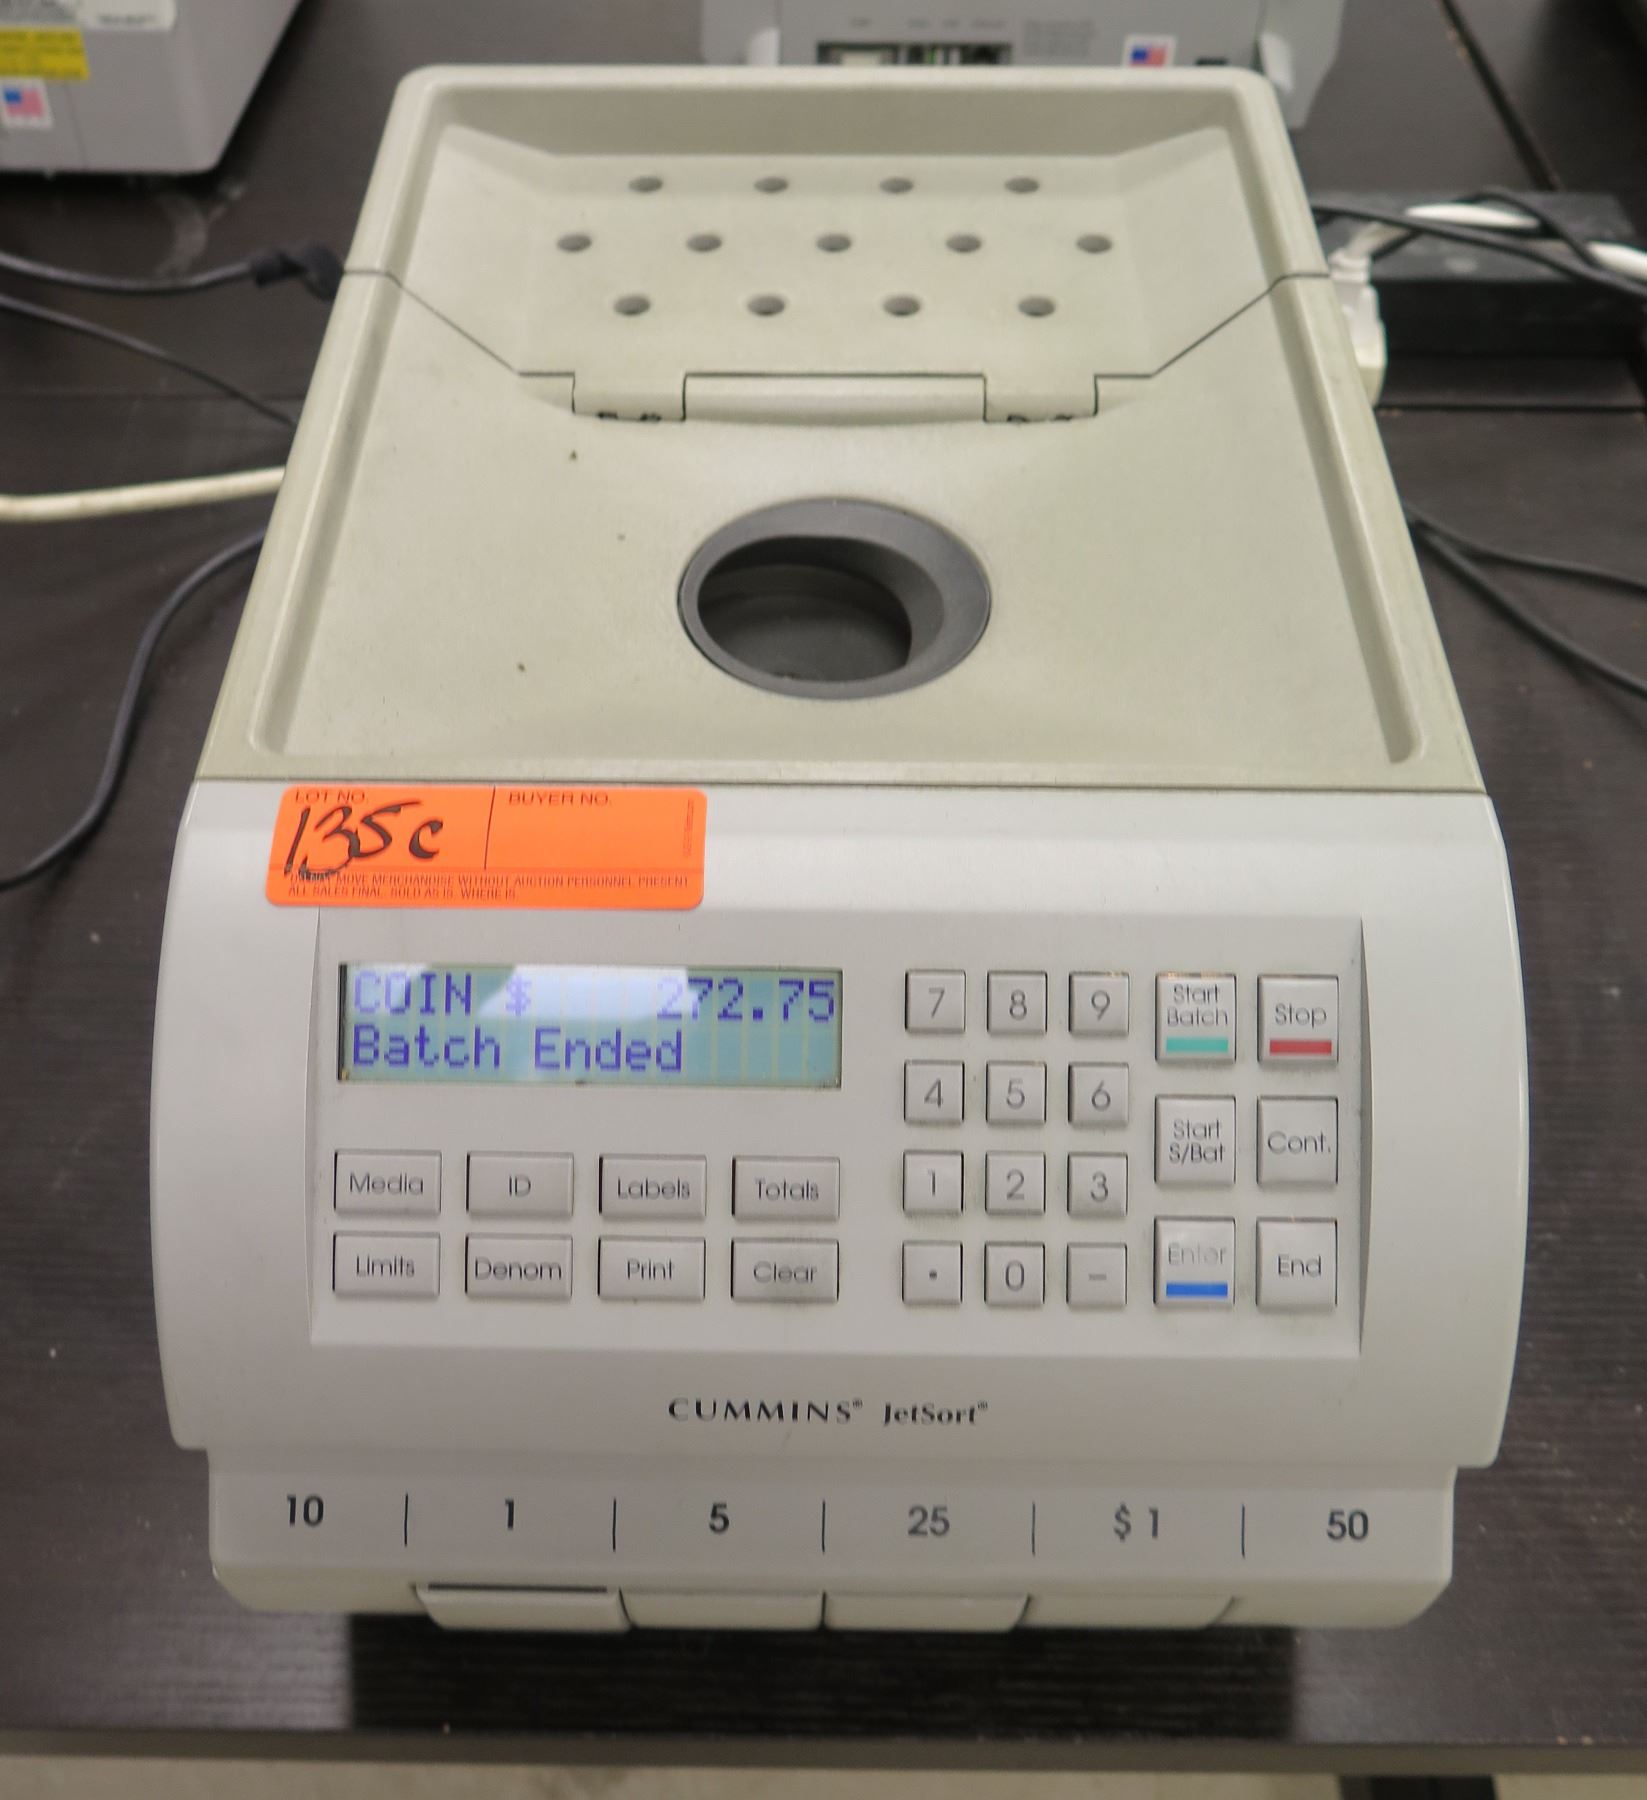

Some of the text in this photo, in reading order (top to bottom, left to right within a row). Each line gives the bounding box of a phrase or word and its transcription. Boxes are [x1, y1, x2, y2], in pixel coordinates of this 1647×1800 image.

[295, 789, 369, 802] LOT NO.
[509, 791, 613, 807] BUYER NO.
[458, 874, 508, 887] WITHOUT
[514, 875, 563, 888] AUCTION
[637, 876, 688, 888] PRESENT
[353, 972, 836, 1022] COIN $ 272.75
[928, 987, 945, 1019] 7
[1008, 990, 1028, 1020] 8
[1091, 990, 1110, 1021] 9
[1173, 984, 1219, 1003] Start
[1166, 1005, 1229, 1025] Batch
[1274, 1002, 1327, 1028] Stop
[353, 1024, 683, 1072] Batch Ended
[924, 1079, 944, 1107] 4
[1006, 1079, 1025, 1110] 5
[1091, 1080, 1111, 1112] 6
[1173, 1119, 1220, 1139] Start
[1169, 1142, 1224, 1164] S/Bat
[1267, 1131, 1331, 1154] Cont.
[349, 1172, 424, 1196] Media
[509, 1174, 531, 1197] ID
[618, 1177, 690, 1200] Labels
[755, 1179, 819, 1201] Totals
[927, 1170, 936, 1196] 1
[1006, 1169, 1025, 1200] 2
[1090, 1171, 1108, 1201] 3
[356, 1255, 415, 1278] Limits
[1168, 1243, 1225, 1265] Enter
[1277, 1255, 1322, 1277] End
[475, 1257, 562, 1281] Denom
[627, 1258, 674, 1281] Print
[753, 1261, 817, 1284] Clear
[1005, 1260, 1025, 1292] 0
[286, 1494, 325, 1528] 10
[504, 1498, 517, 1530] 1
[709, 1502, 731, 1534] 5
[907, 1505, 951, 1538] 25
[1326, 1509, 1370, 1542] 50
